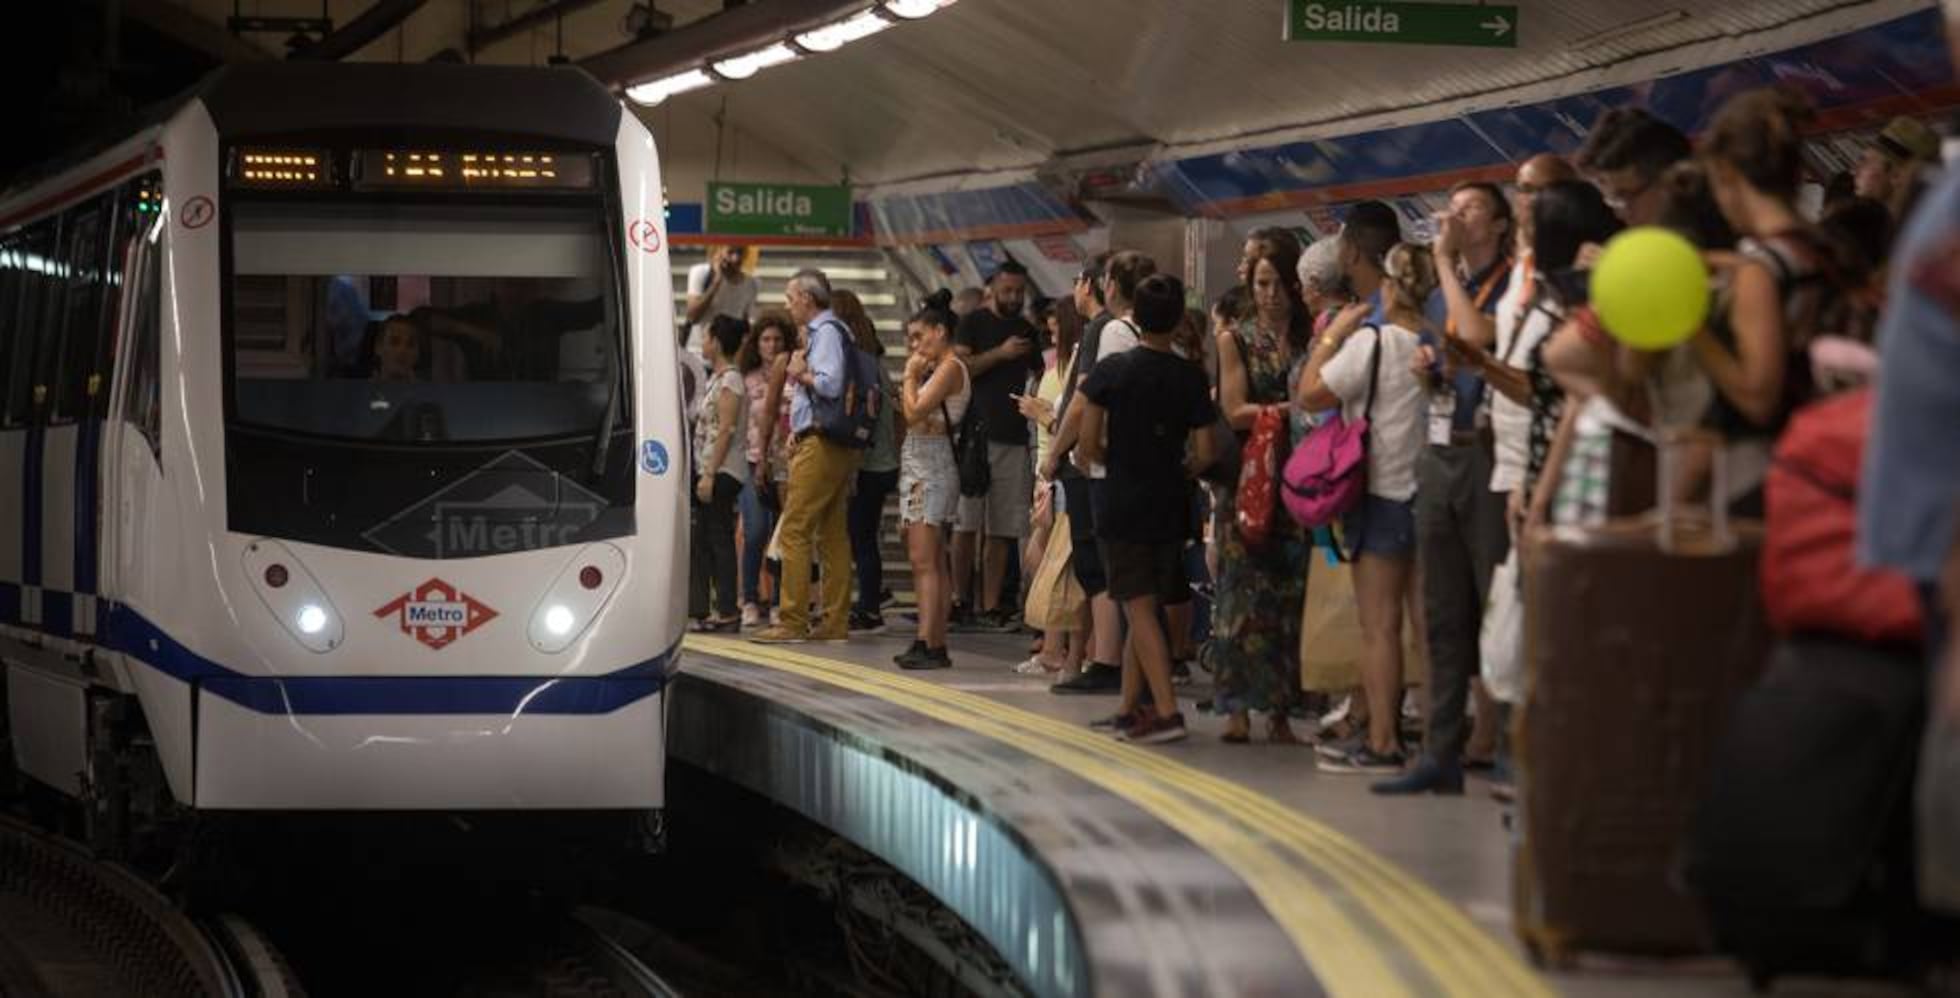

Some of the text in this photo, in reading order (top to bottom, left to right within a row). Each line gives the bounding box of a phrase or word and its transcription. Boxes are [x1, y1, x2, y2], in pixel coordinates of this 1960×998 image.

[1304, 3, 1400, 33] Salida
[715, 187, 812, 216] Salida
[409, 606, 463, 622] Metro
